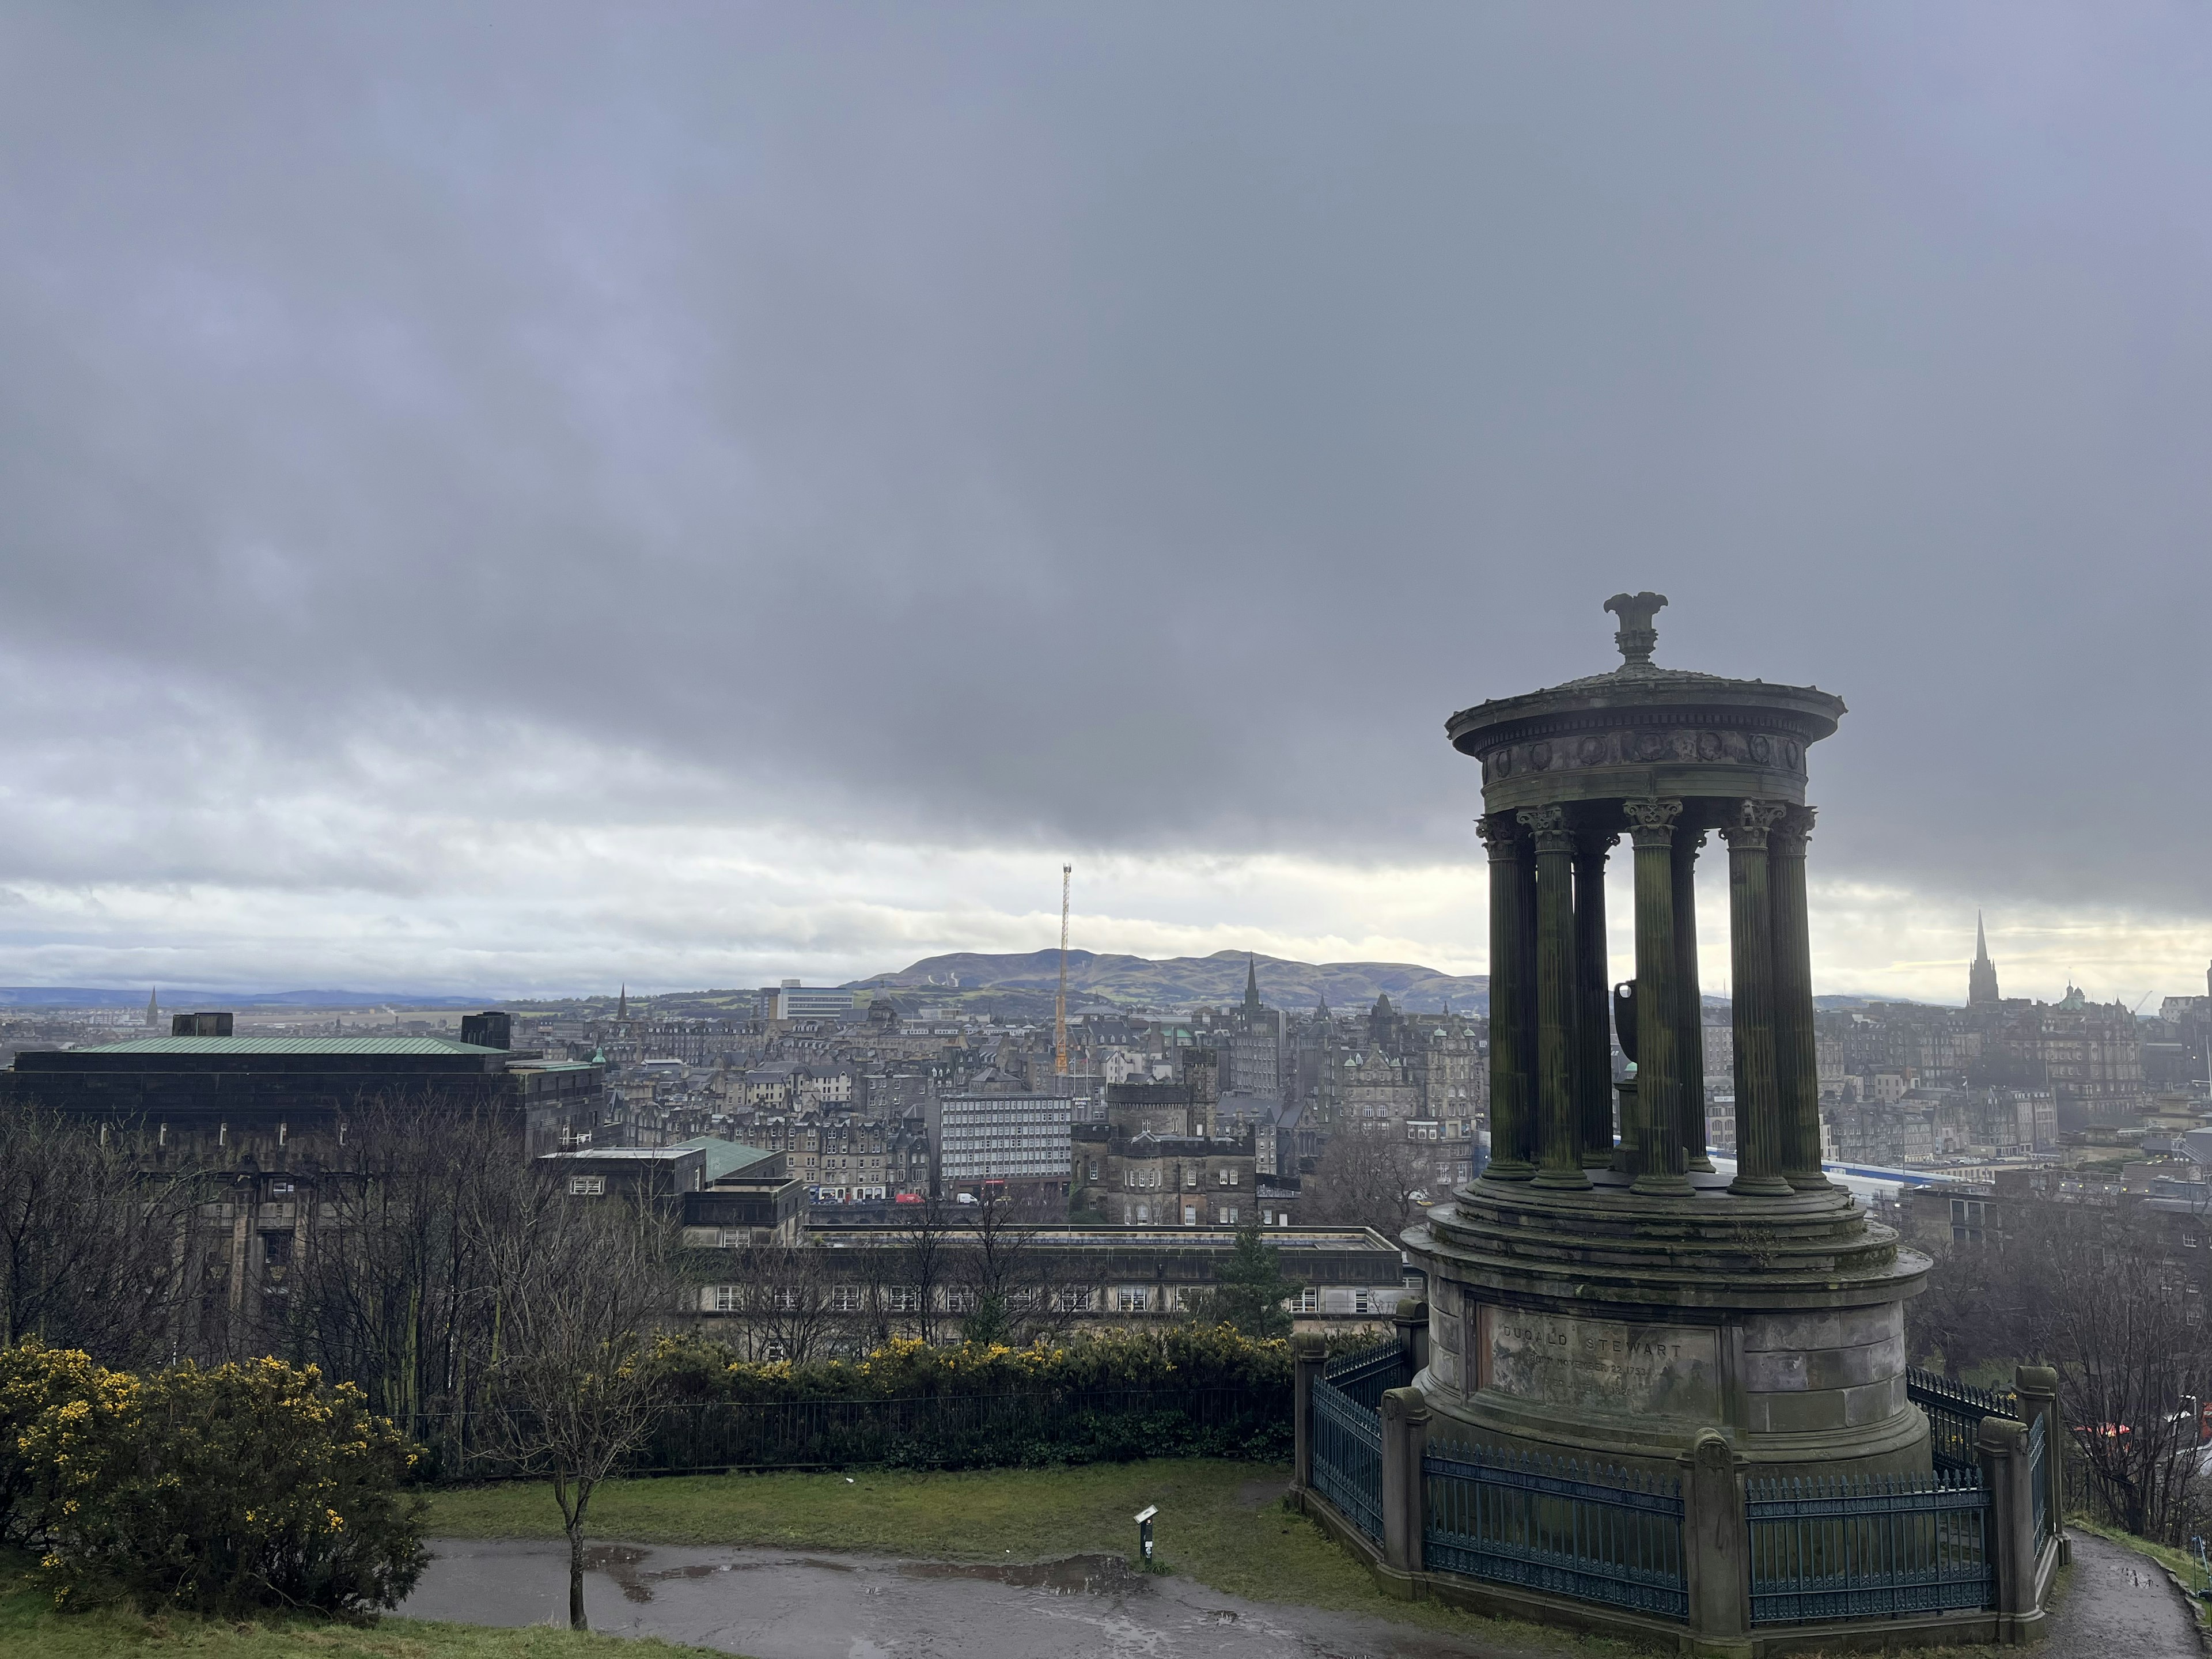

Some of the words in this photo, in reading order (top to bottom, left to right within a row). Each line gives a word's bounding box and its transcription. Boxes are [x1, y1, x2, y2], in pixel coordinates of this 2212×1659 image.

[1503, 1325, 1567, 1346] DUGALD
[1586, 1338, 1681, 1357] STEWART
[1557, 1358, 1607, 1372] NOVEMBER
[1611, 1365, 1623, 1374] 22
[1626, 1366, 1646, 1376] 1753
